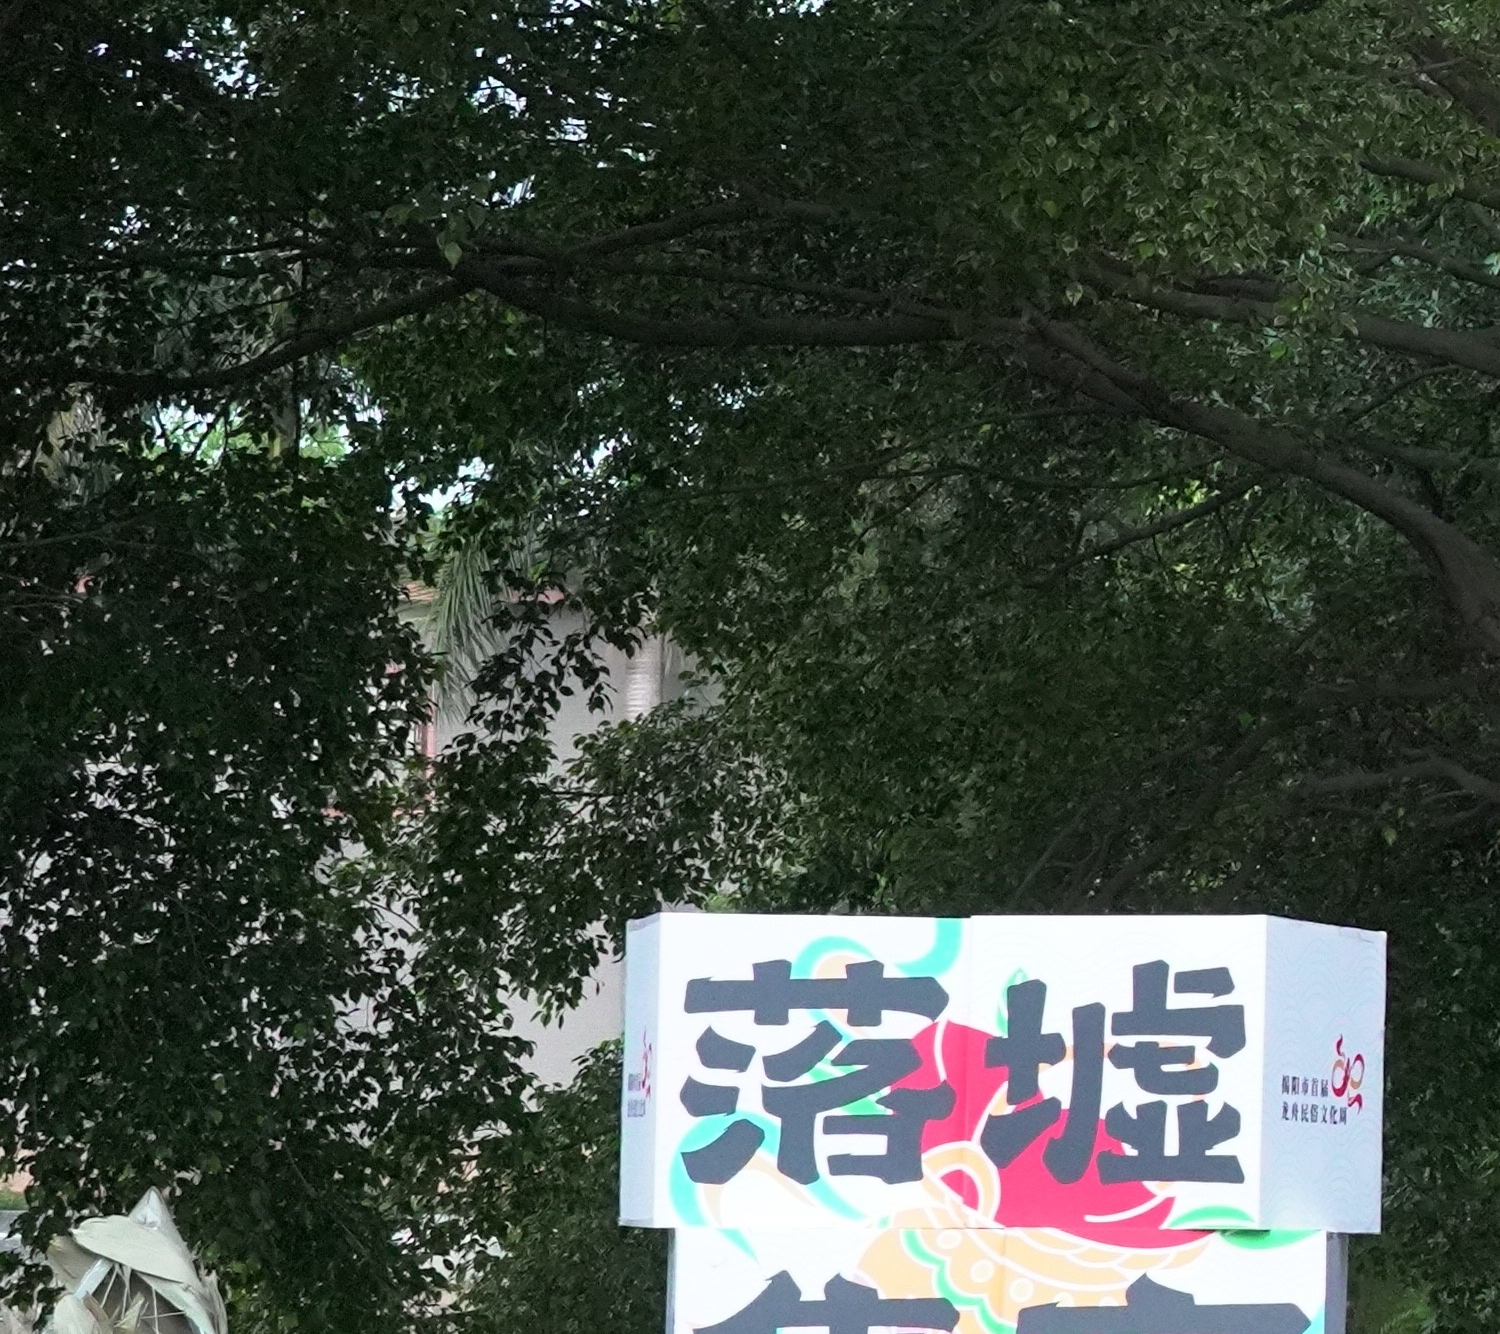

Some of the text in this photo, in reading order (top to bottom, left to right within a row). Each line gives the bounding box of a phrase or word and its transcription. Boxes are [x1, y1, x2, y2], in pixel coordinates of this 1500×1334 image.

[683, 959, 1245, 1185] 落墟
[1281, 1074, 1329, 1097] 揭阳市首届
[1282, 1101, 1347, 1125] 龙舟民俗文化周
